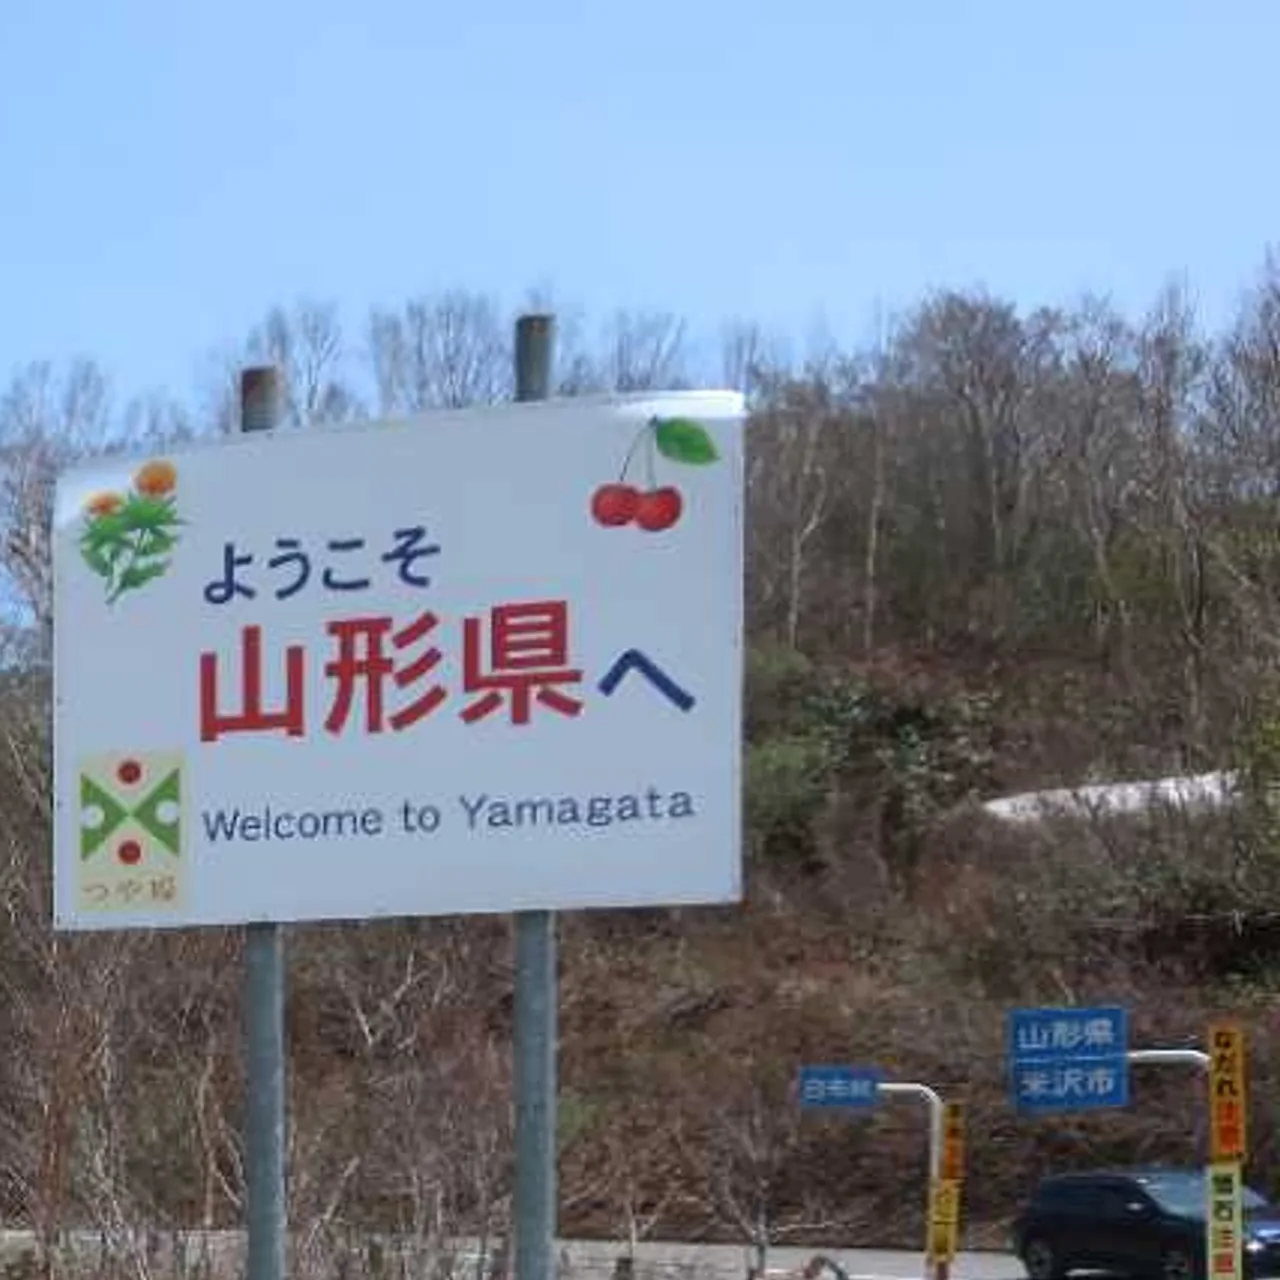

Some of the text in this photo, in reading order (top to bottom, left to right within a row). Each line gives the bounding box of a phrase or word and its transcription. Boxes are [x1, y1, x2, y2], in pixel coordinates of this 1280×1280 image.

[203, 526, 441, 604] ようこそ
[200, 600, 696, 742] 山形県へ
[202, 785, 695, 842] Welcome to Yamagata
[1017, 1018, 1117, 1050] 山形県
[1018, 1067, 1115, 1098] 米沢市
